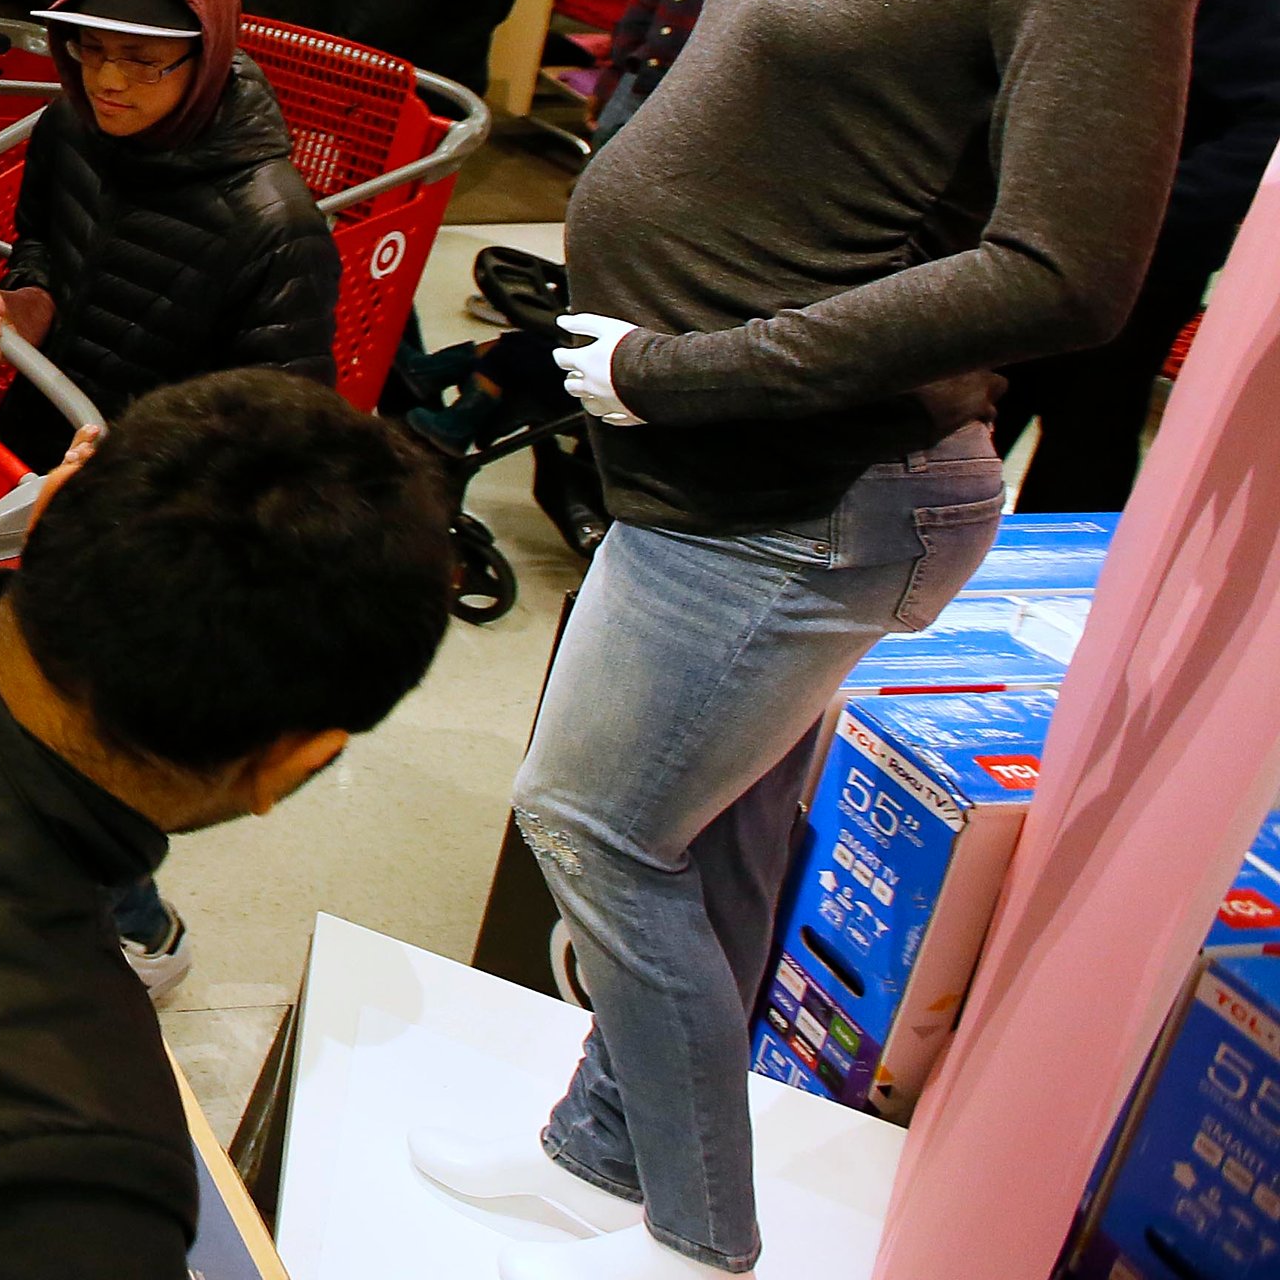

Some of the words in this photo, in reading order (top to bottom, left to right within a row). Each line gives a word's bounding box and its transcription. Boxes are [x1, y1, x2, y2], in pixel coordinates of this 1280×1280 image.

[844, 723, 879, 756] TCL
[886, 757, 921, 791] ROKU
[920, 787, 946, 811] TV
[879, 863, 902, 887] TV
[1214, 992, 1263, 1036] TCL
